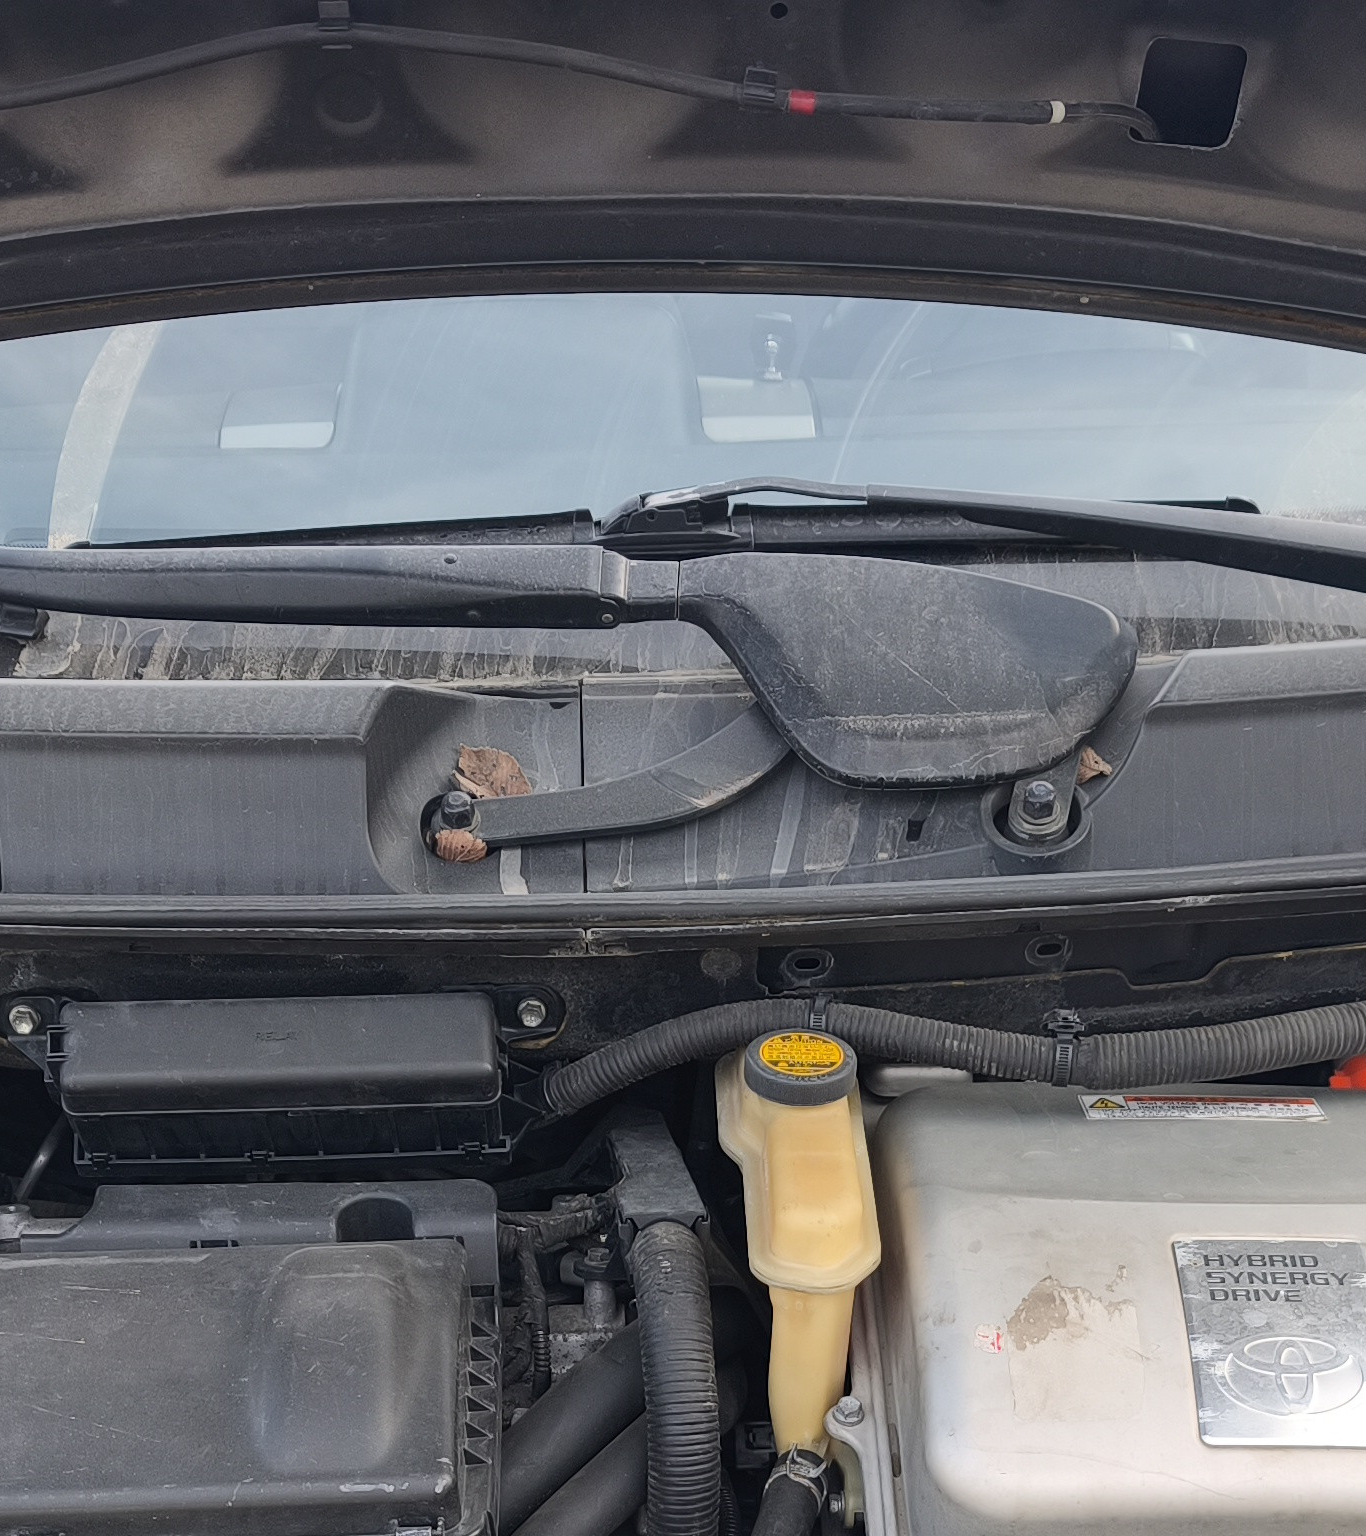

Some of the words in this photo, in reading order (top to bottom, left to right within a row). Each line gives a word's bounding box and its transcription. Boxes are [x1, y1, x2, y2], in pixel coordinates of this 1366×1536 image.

[1203, 1253, 1319, 1268] HYBRID
[1205, 1271, 1350, 1286] SYNERGY
[1208, 1288, 1303, 1303] DRIVE
